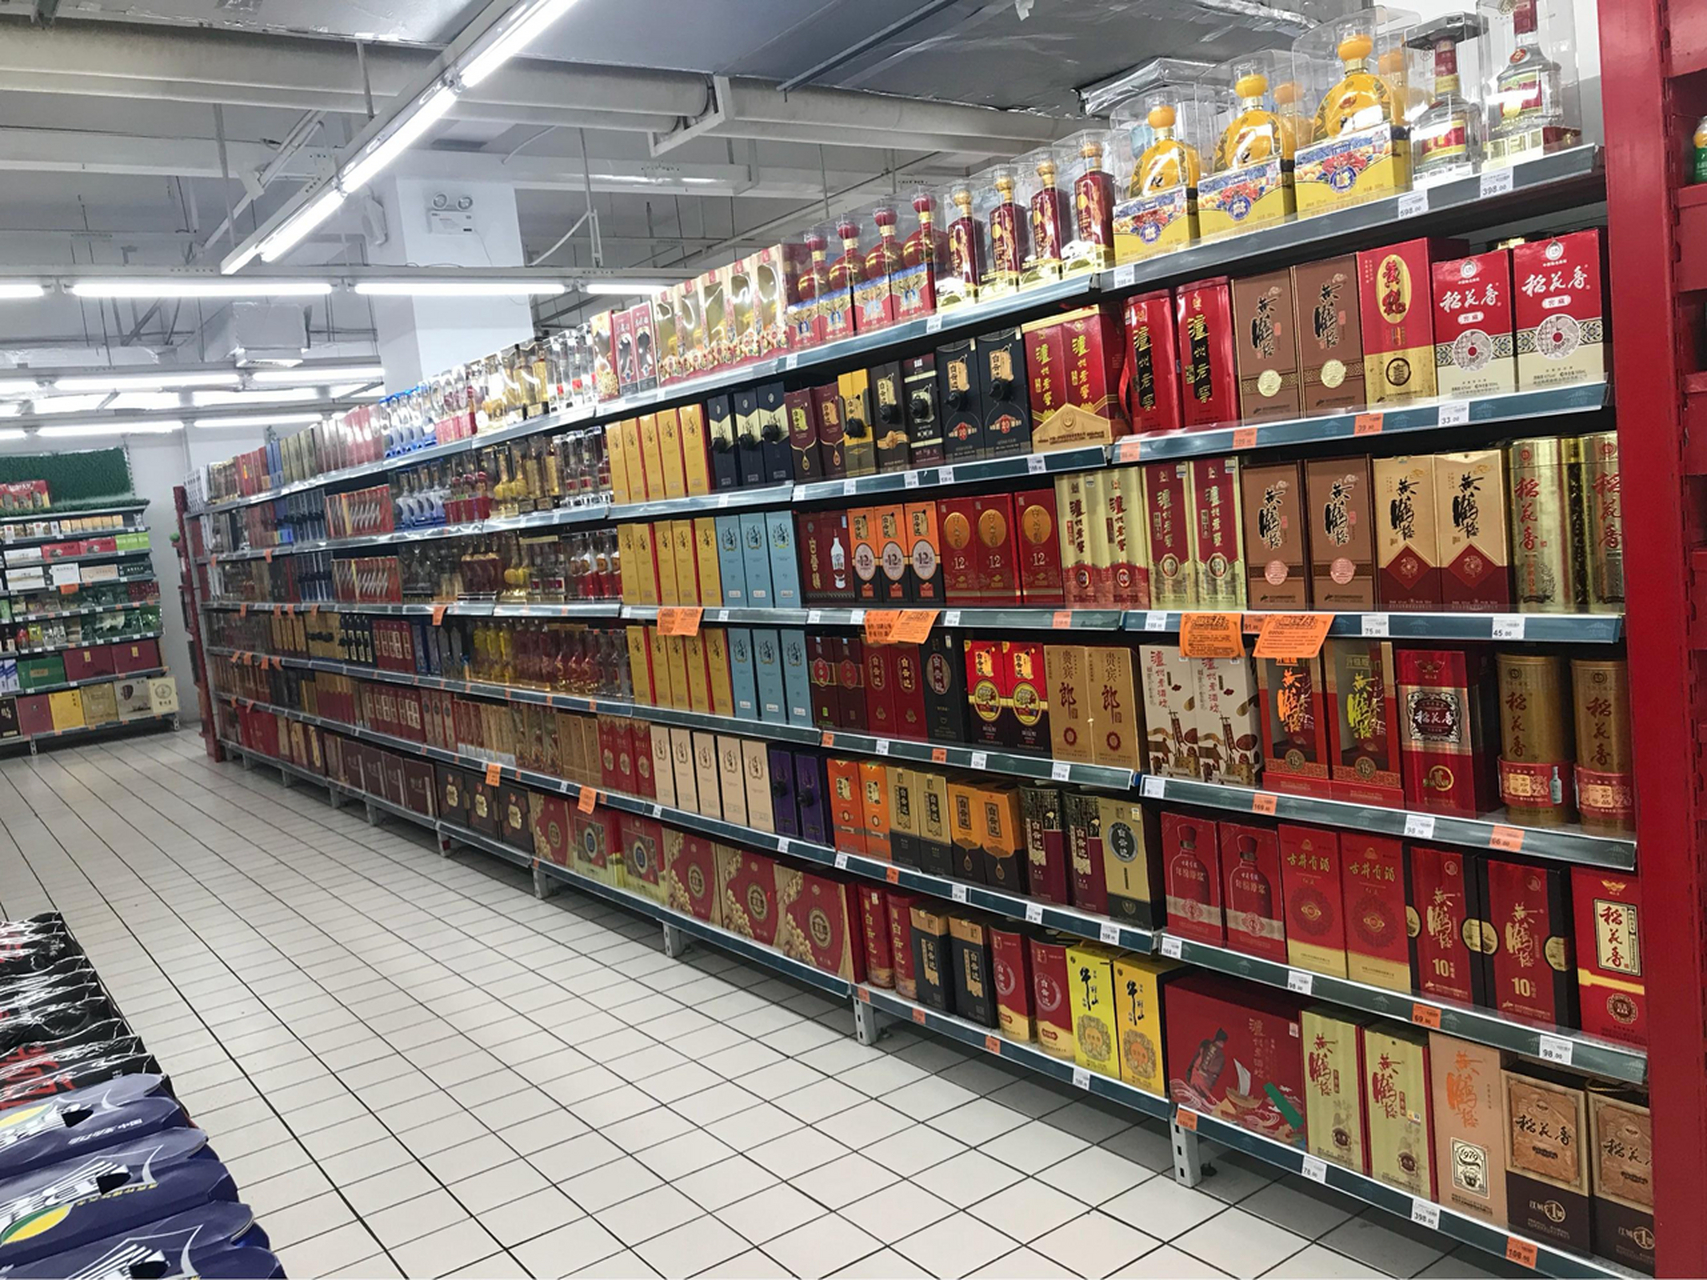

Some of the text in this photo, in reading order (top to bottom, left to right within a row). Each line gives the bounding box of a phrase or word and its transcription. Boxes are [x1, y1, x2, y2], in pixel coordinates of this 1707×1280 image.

[1514, 476, 1540, 550] 稻花香
[859, 554, 869, 566] 12
[887, 553, 898, 566] 12
[918, 551, 929, 564] 12
[954, 556, 966, 570] 12
[989, 555, 1001, 568] 12
[1033, 552, 1046, 566] 12
[1286, 852, 1331, 873] 古井贡酒
[1349, 860, 1396, 883] 古井贡酒
[1599, 905, 1624, 968] 稻花香
[1432, 958, 1449, 977] 10
[1511, 977, 1530, 997] 10
[1542, 1049, 1564, 1061] 98.00
[1514, 1113, 1572, 1146] 稻花香
[1460, 1148, 1479, 1162] 1979
[1602, 1138, 1652, 1165] 稻花
